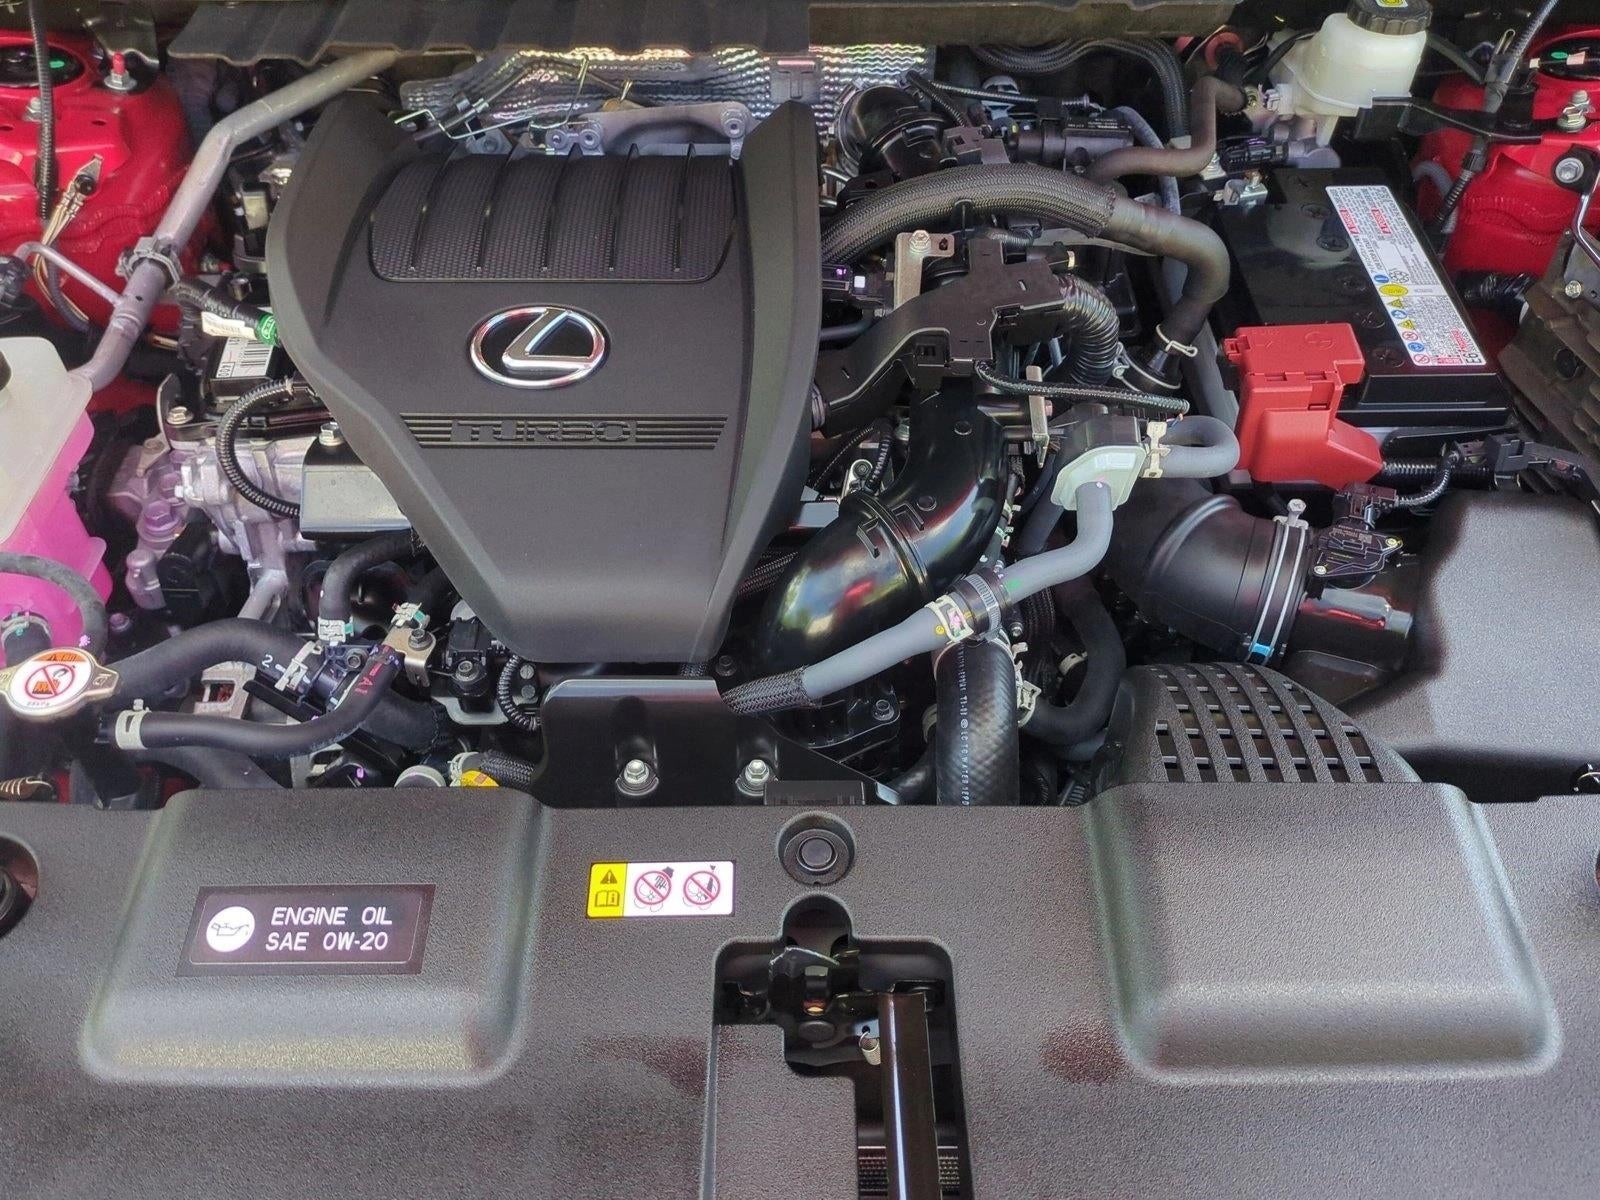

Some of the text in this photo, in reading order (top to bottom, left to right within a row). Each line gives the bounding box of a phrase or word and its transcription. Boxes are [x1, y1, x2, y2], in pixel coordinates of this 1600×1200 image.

[456, 419, 632, 442] TURBO
[261, 653, 274, 669] 2
[270, 906, 393, 926] ENGINE OIL
[264, 931, 389, 951] SAE 0W-20
